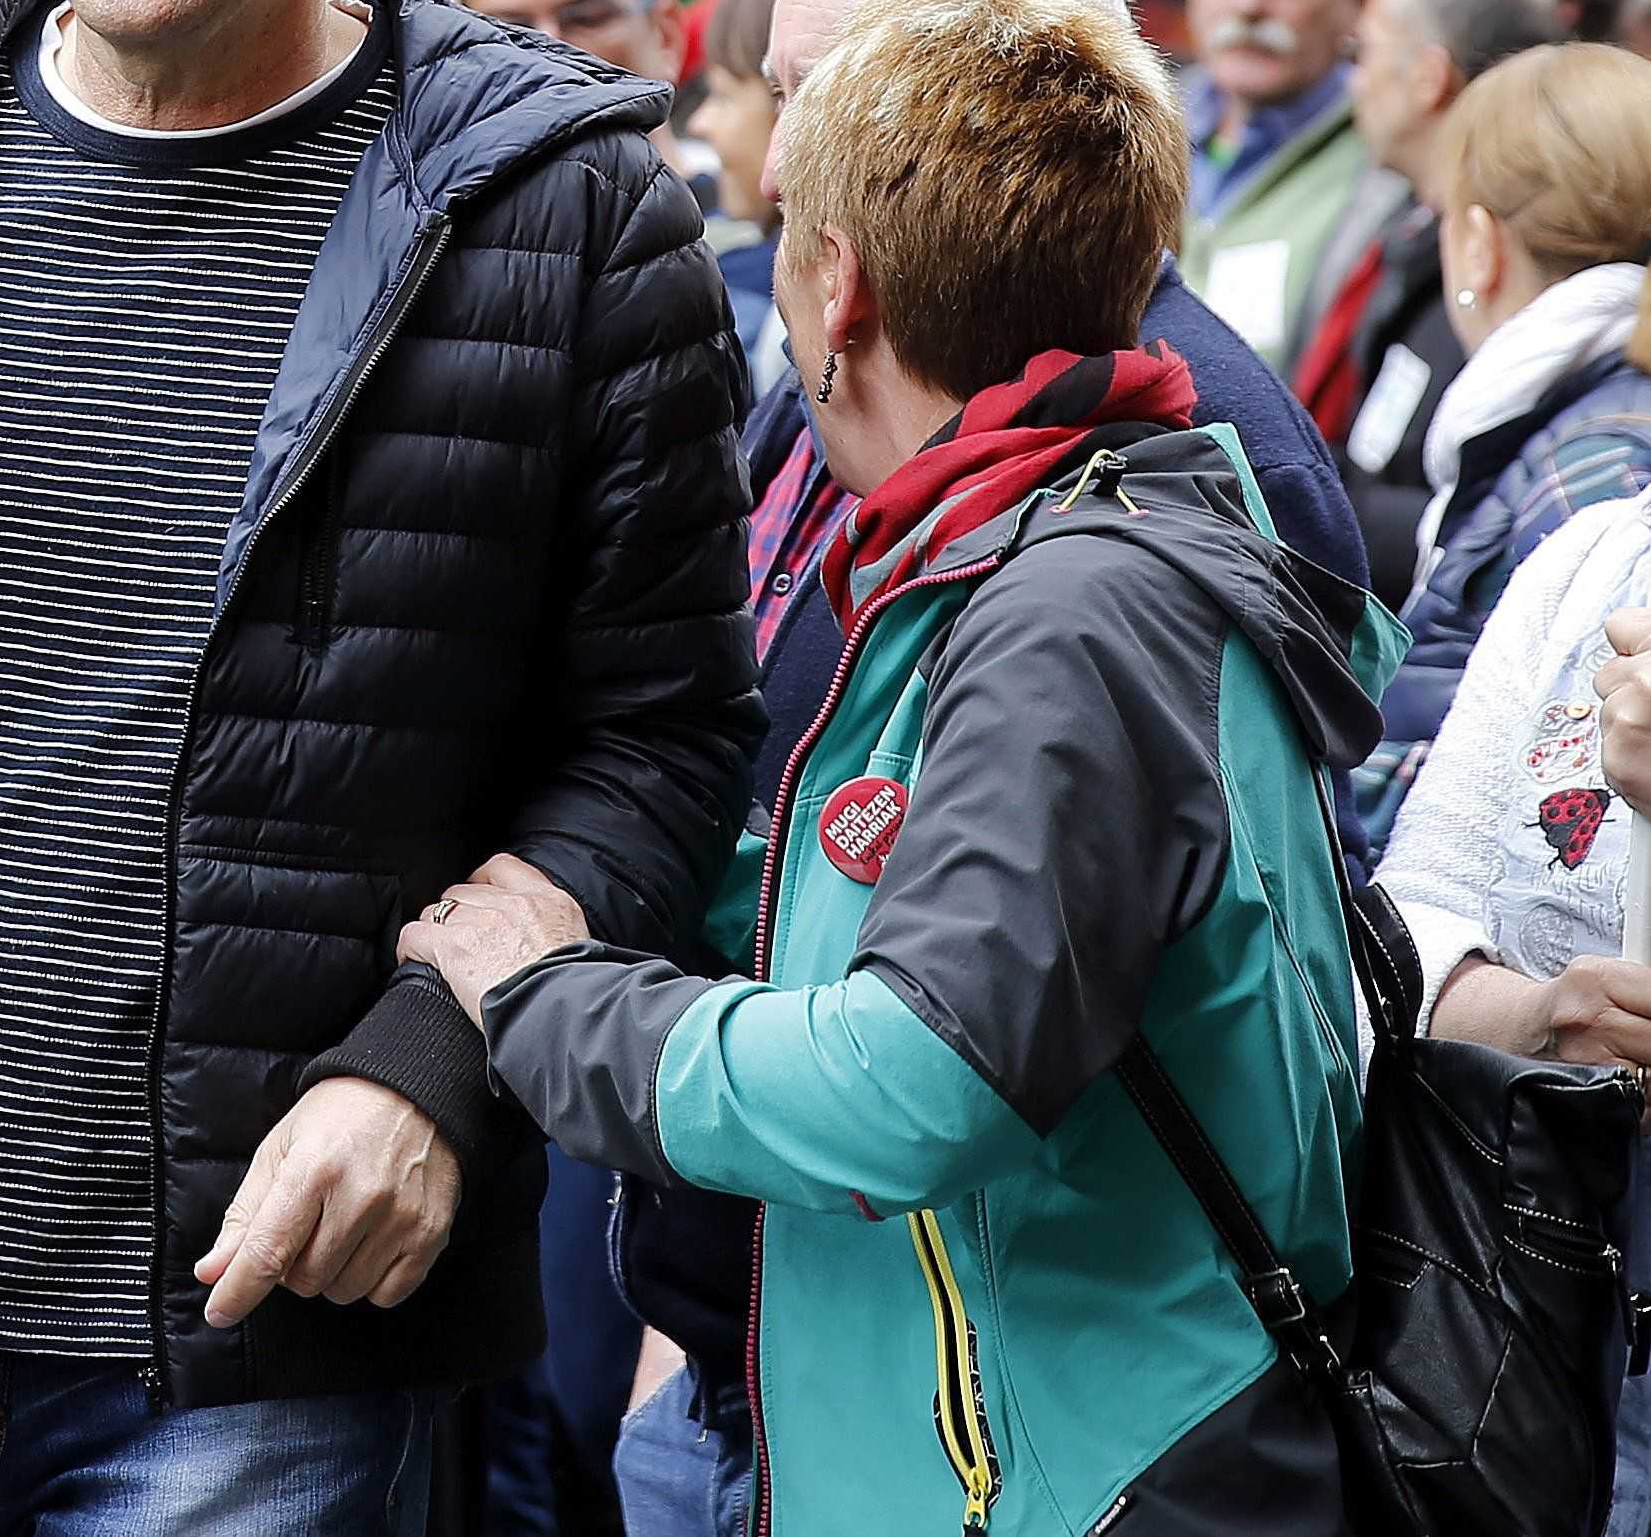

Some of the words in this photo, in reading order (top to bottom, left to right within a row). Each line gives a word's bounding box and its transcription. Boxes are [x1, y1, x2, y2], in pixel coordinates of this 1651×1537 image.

[825, 801, 863, 841] MUGI
[835, 785, 897, 851] DAITEZEN
[846, 801, 902, 860] HARRIAK
